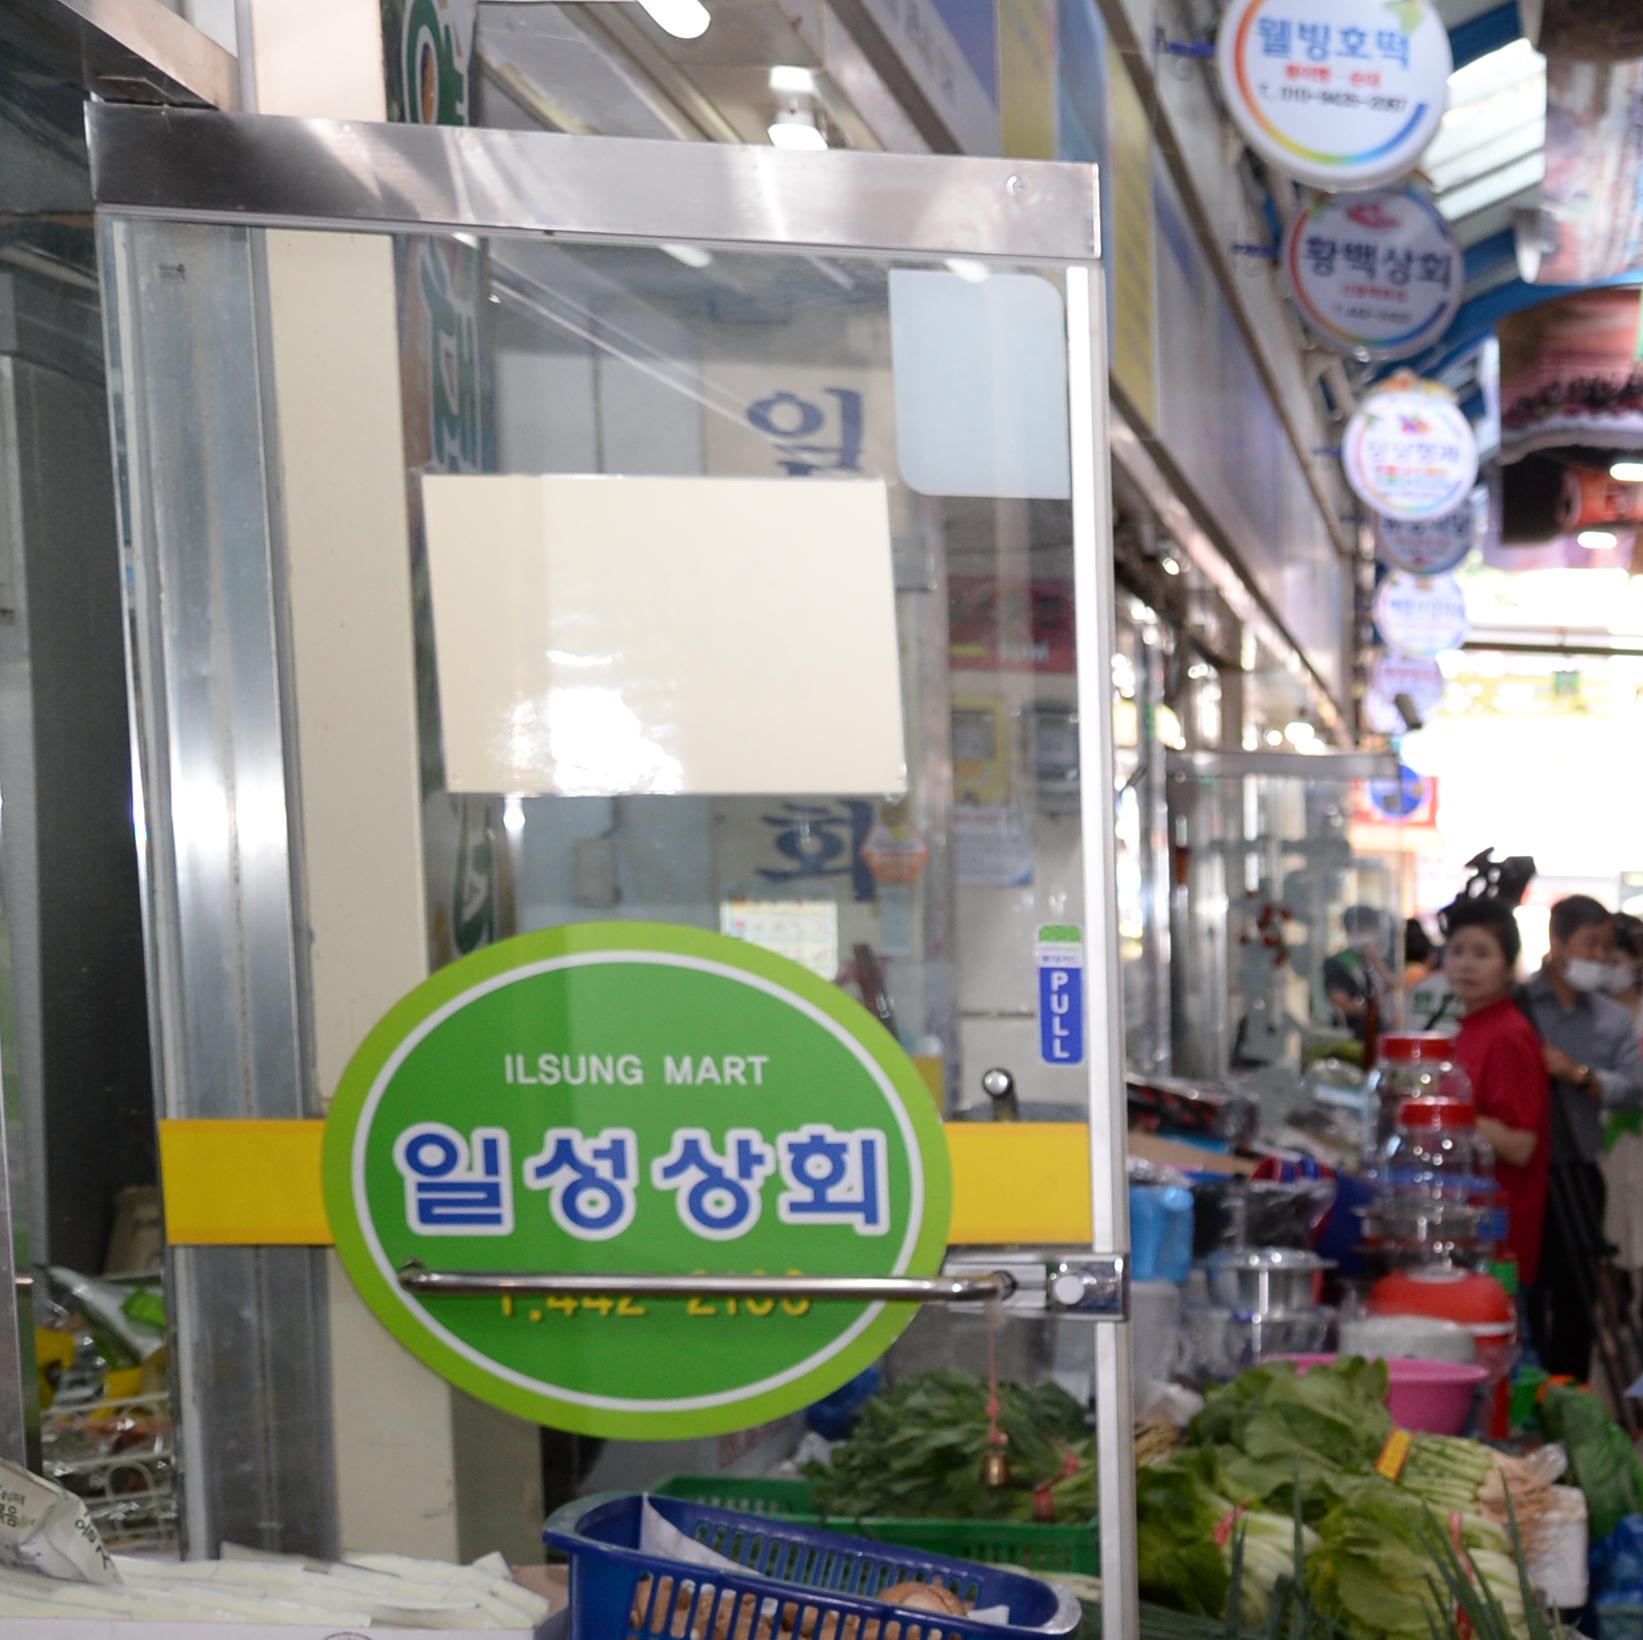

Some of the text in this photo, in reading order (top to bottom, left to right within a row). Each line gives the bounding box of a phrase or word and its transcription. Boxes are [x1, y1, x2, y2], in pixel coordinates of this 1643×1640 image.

[1257, 17, 1410, 70] 웰빙호떡
[1050, 969, 1071, 1059] PULL
[504, 1053, 769, 1087] ILSUNG MART
[393, 1122, 891, 1242] 일성상회
